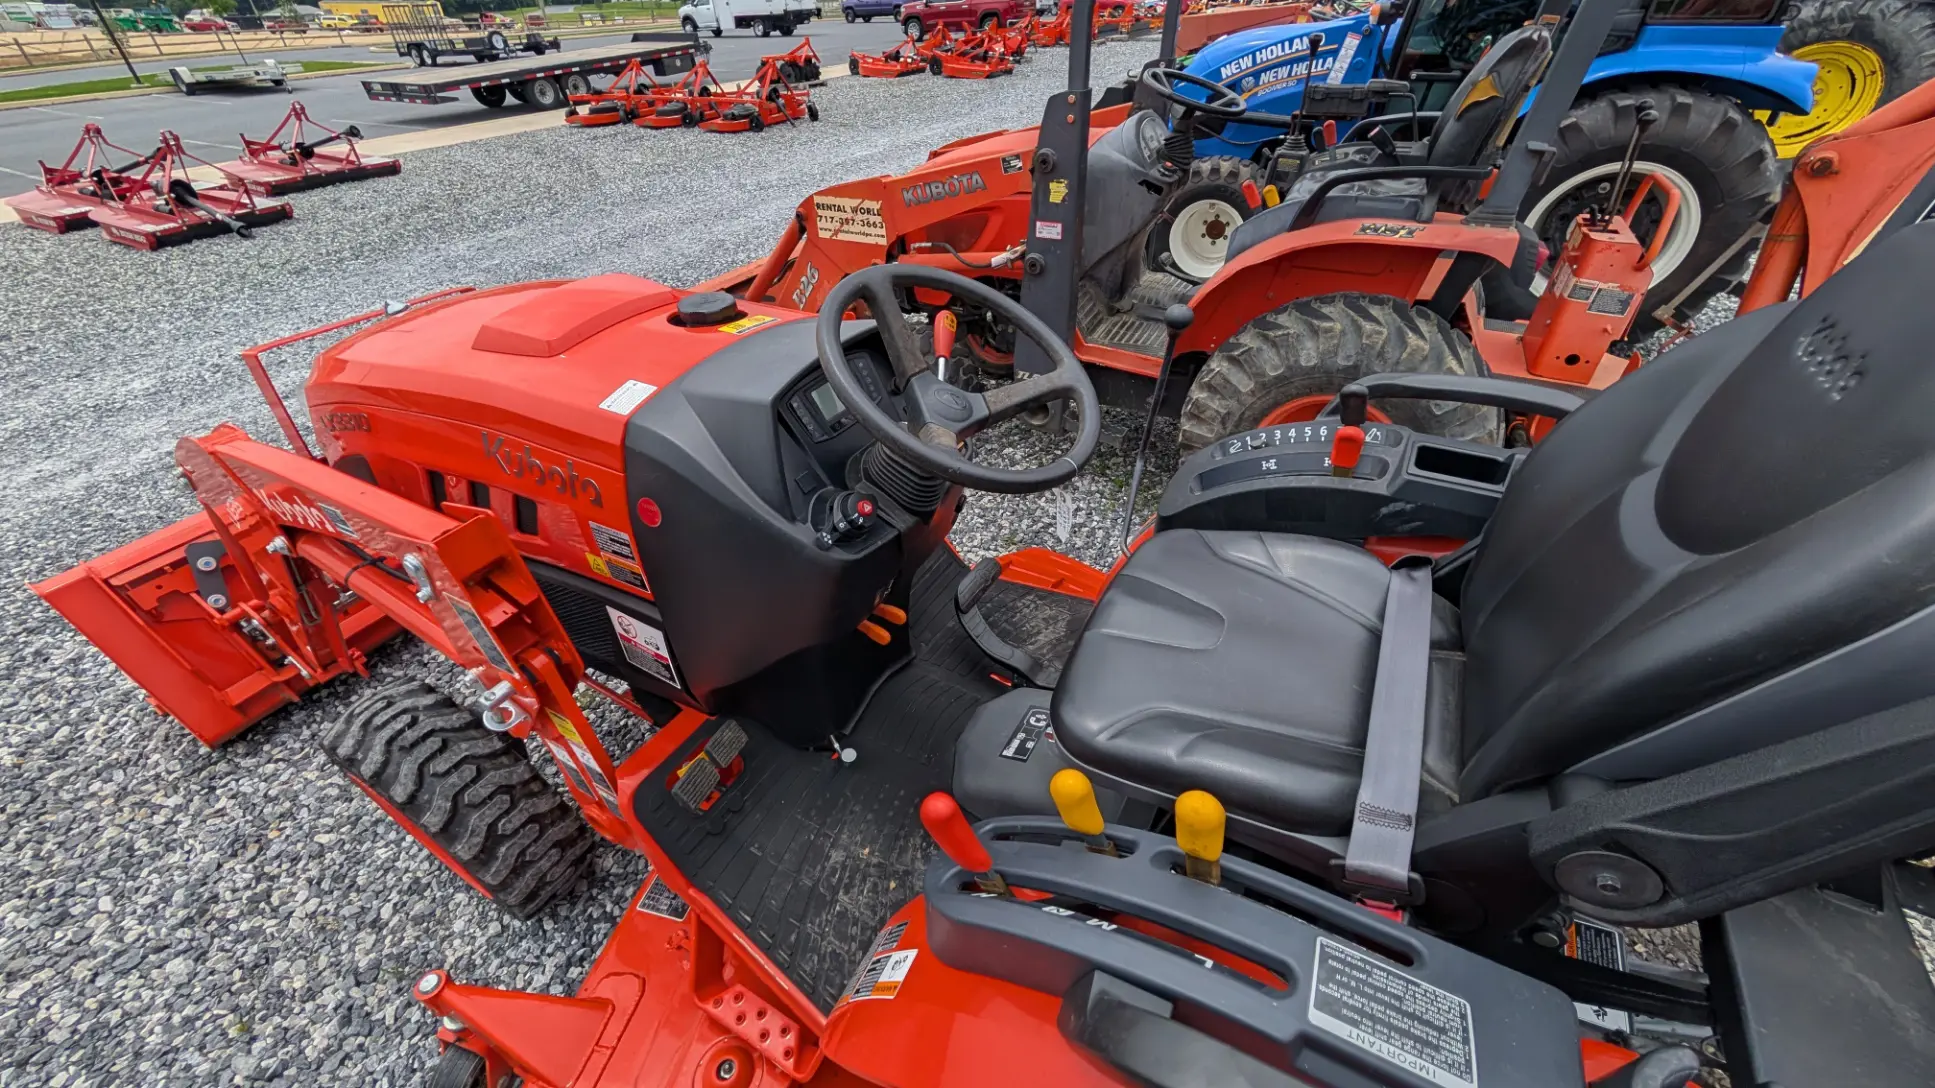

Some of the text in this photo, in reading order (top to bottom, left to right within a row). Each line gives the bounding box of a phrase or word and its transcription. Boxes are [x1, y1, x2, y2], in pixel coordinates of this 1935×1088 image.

[1221, 56, 1253, 79] NEW
[1259, 57, 1334, 85] NEW HOLLA
[1257, 82, 1287, 97] BOOMER
[902, 170, 987, 208] KUBOTA
[815, 202, 848, 213] RENTAL
[792, 260, 820, 311] B26
[1274, 430, 1281, 440] 3
[1288, 428, 1297, 438] 4
[1304, 426, 1312, 437] 5
[1320, 426, 1328, 436] 6
[481, 431, 604, 509] Kubota
[251, 487, 337, 534] Kubota
[1086, 918, 1117, 932] M
[1346, 1029, 1437, 1079] IMPORTANT
